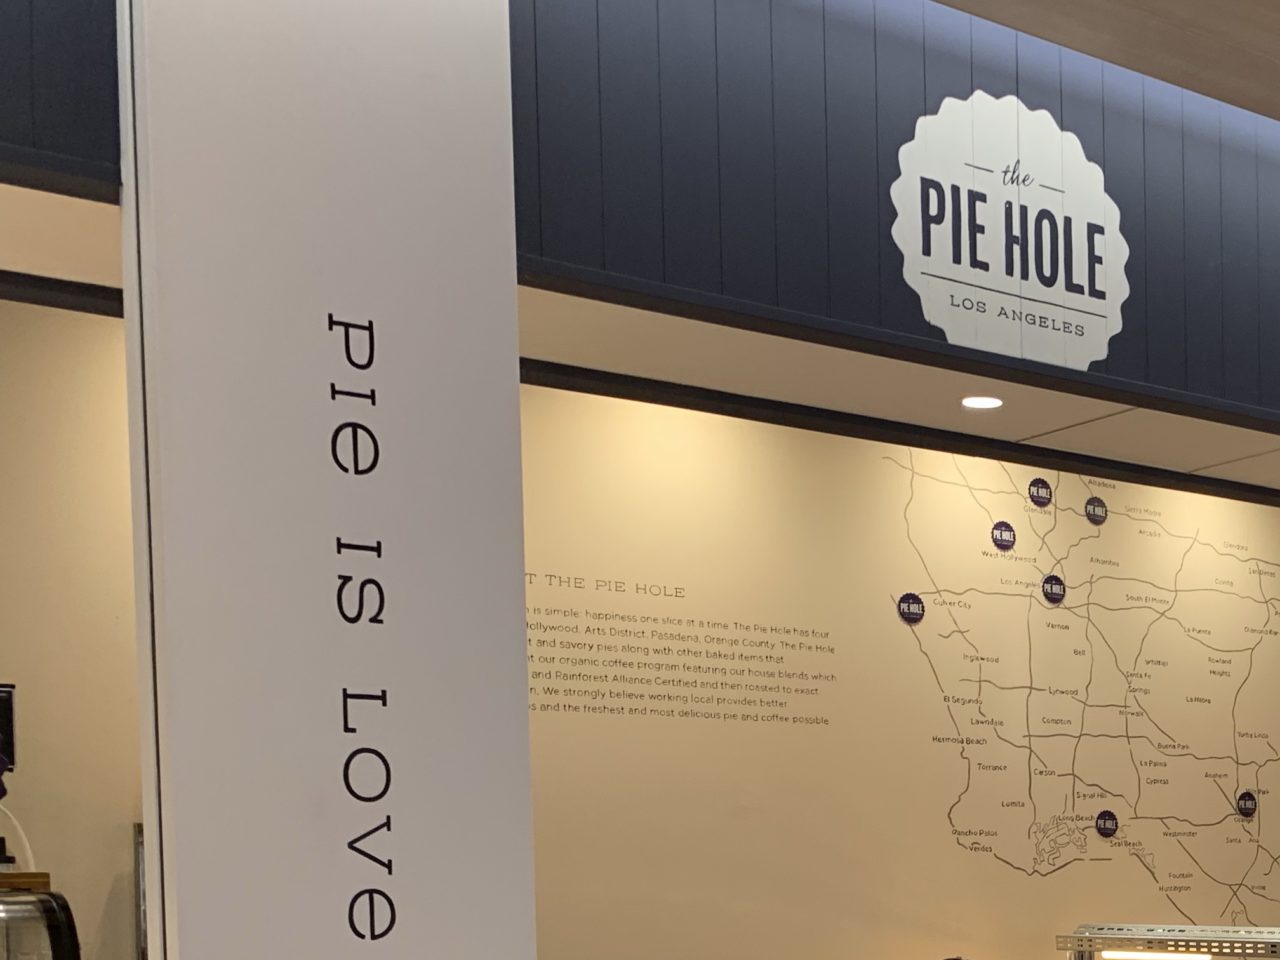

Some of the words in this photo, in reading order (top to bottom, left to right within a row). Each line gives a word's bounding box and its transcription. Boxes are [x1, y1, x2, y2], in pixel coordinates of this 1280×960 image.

[1001, 159, 1035, 187] the
[920, 176, 990, 272] PIE
[1004, 200, 1106, 300] HOLE
[950, 294, 987, 313] LOS
[997, 306, 1085, 337] ANGELES
[1030, 486, 1038, 496] PIE
[1038, 487, 1051, 498] HOLE
[993, 530, 1001, 539] PIE
[1002, 530, 1014, 541] HOLE
[335, 537, 385, 625] IS
[545, 575, 585, 588] THE
[595, 580, 626, 592] PIE
[636, 584, 685, 597] HOLE
[1044, 583, 1052, 593] PIE
[900, 603, 910, 613] PIE
[910, 603, 923, 614] HOLE
[534, 607, 542, 615] is
[586, 609, 637, 623] happiness
[640, 615, 658, 623] one
[662, 614, 683, 625] slice
[686, 619, 694, 627] at
[734, 622, 751, 632] The
[754, 624, 768, 634] Pie
[771, 626, 791, 635] Hole
[794, 627, 809, 637] has
[812, 629, 830, 639] four
[537, 638, 556, 647] and
[559, 641, 594, 652] savory
[597, 643, 618, 653] pies
[621, 645, 649, 656] along
[653, 646, 673, 656] with
[676, 648, 702, 658] other
[706, 650, 735, 661] baked
[738, 653, 764, 663] items
[765, 655, 784, 664] that
[585, 626, 607, 636] Arts
[704, 635, 740, 648] Orange
[780, 641, 796, 650] The
[799, 643, 813, 651] Pie
[816, 645, 836, 654] Hole
[538, 655, 556, 664] our
[559, 656, 599, 667] organic
[602, 658, 634, 669] coffee
[637, 661, 680, 672] program
[683, 663, 727, 676] featuring
[729, 667, 745, 676] our
[749, 667, 776, 678] house
[778, 670, 809, 680] blends
[811, 672, 837, 682] which
[532, 670, 551, 680] and
[555, 671, 608, 683] Rainforest
[612, 674, 652, 685] Alliance
[654, 676, 697, 688] Certified
[700, 680, 718, 690] and
[720, 681, 743, 691] then
[745, 683, 780, 693] roasted
[783, 685, 792, 694] to
[794, 687, 819, 695] exact
[543, 686, 559, 696] We
[563, 687, 606, 700] strongly
[609, 689, 645, 700] believe
[648, 692, 688, 704] working
[691, 694, 714, 704] local
[717, 695, 757, 707] provides
[760, 698, 787, 708] better
[540, 702, 560, 712] and
[563, 703, 580, 712] the
[583, 704, 624, 715] freshest
[628, 706, 647, 715] and
[650, 708, 675, 717] most
[678, 709, 721, 720] delicious
[723, 712, 738, 722] pie
[741, 712, 758, 722] and
[761, 713, 789, 723] coffee
[792, 715, 829, 726] possible
[932, 736, 964, 744] Hermosa
[966, 737, 987, 745] Beach
